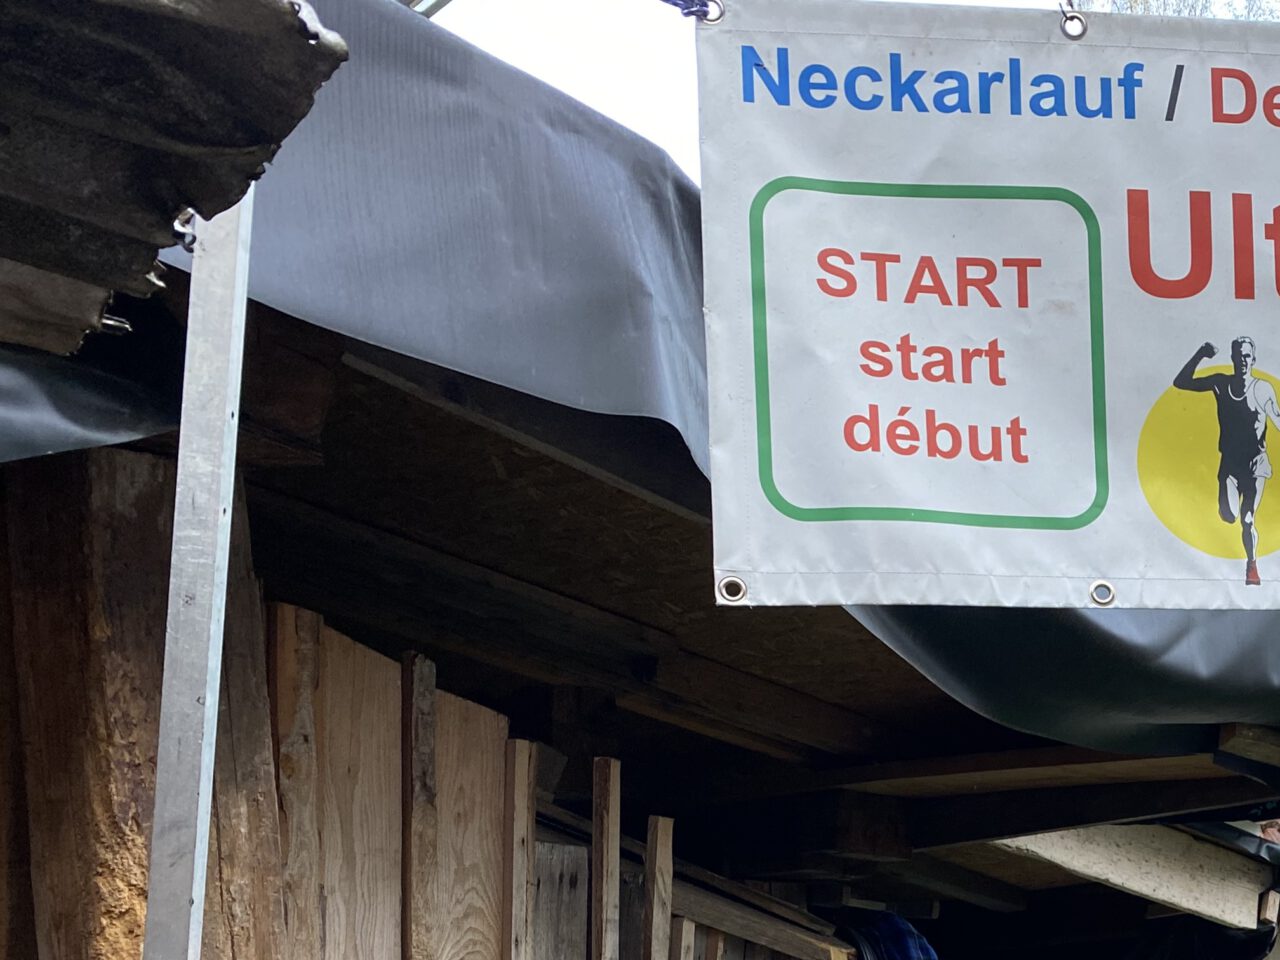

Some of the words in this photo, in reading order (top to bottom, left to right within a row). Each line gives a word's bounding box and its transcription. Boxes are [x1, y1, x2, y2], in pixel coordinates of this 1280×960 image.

[741, 46, 1144, 119] Neckarlauf
[1166, 65, 1184, 121] /
[816, 248, 1042, 308] START
[860, 335, 1006, 386] start
[844, 404, 1028, 464] début
